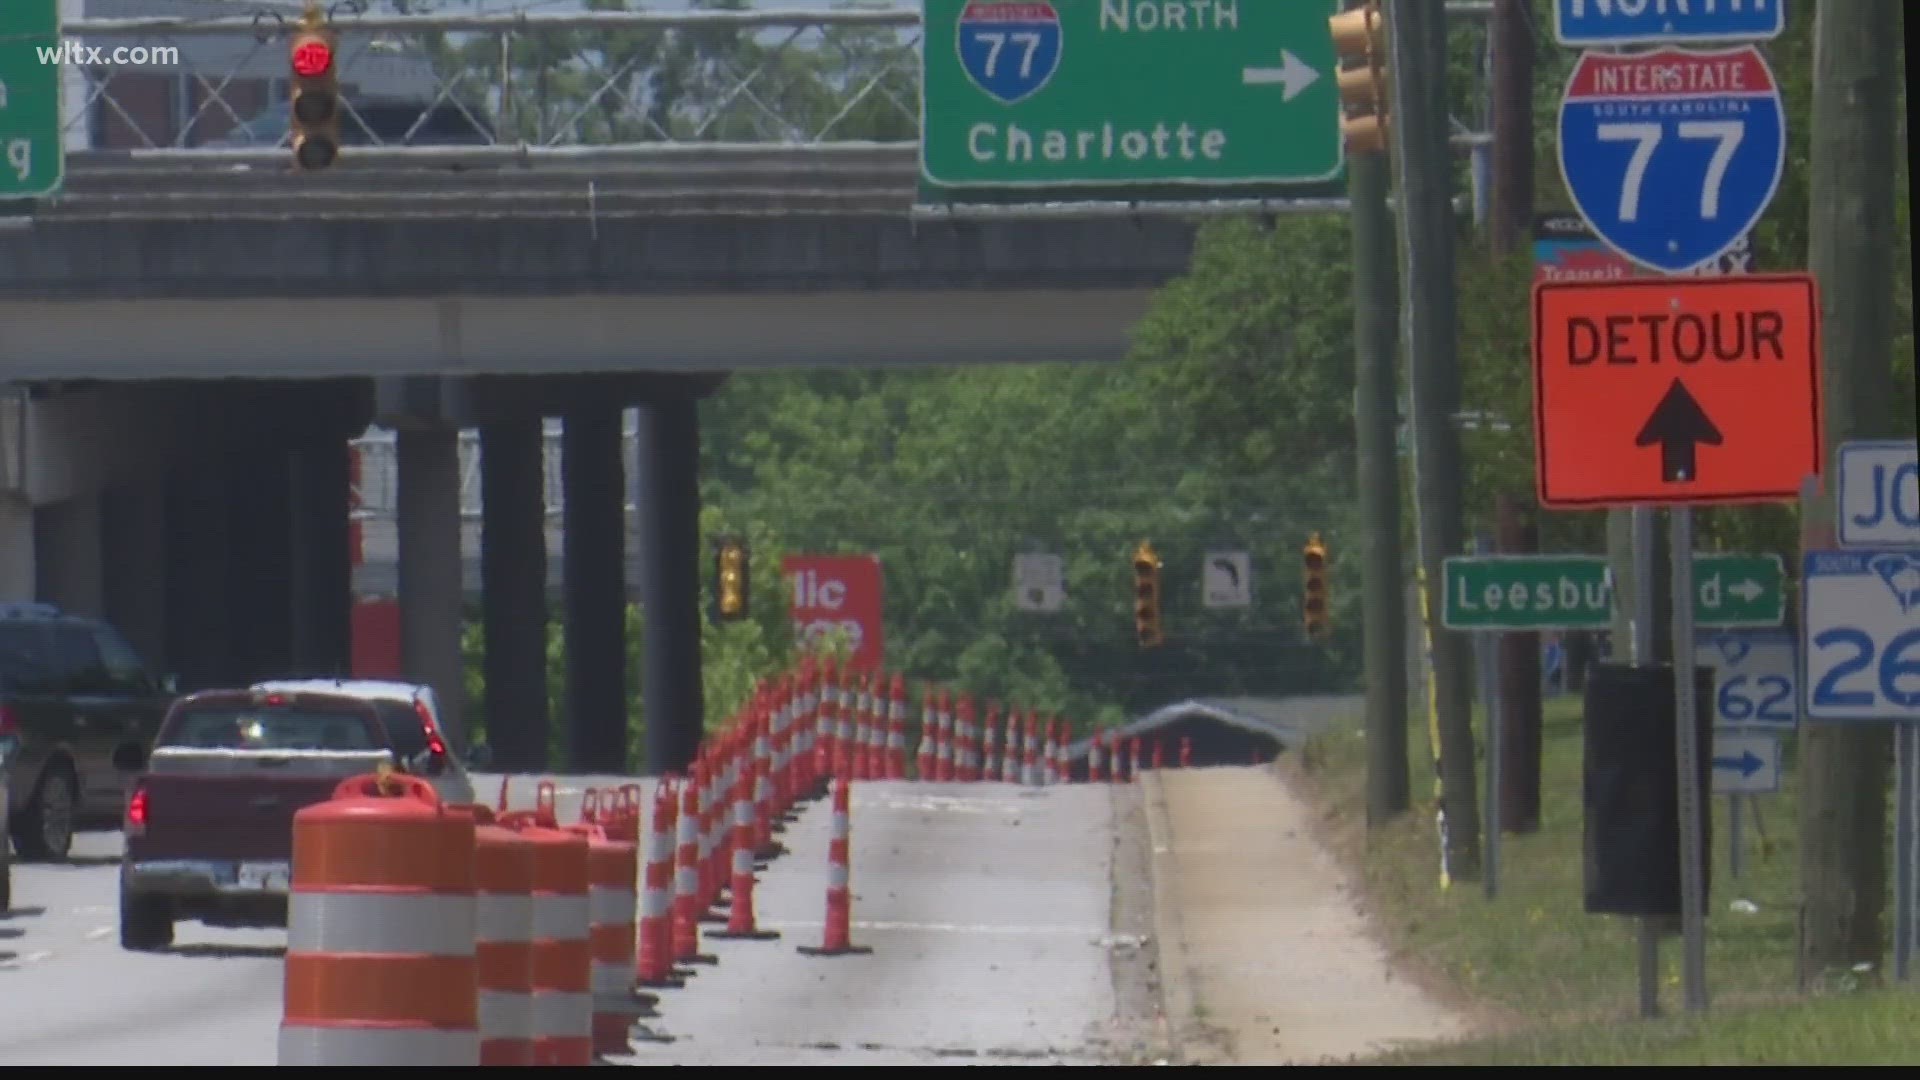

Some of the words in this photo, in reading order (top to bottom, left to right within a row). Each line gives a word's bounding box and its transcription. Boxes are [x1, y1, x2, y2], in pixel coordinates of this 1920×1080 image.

[1100, 0, 1237, 32] NORTH
[974, 32, 1041, 78] 77
[1593, 60, 1746, 93] INTERSTATE
[968, 122, 1227, 162] Charlotte
[1597, 121, 1745, 222] 77
[1567, 311, 1785, 366] DETOUR
